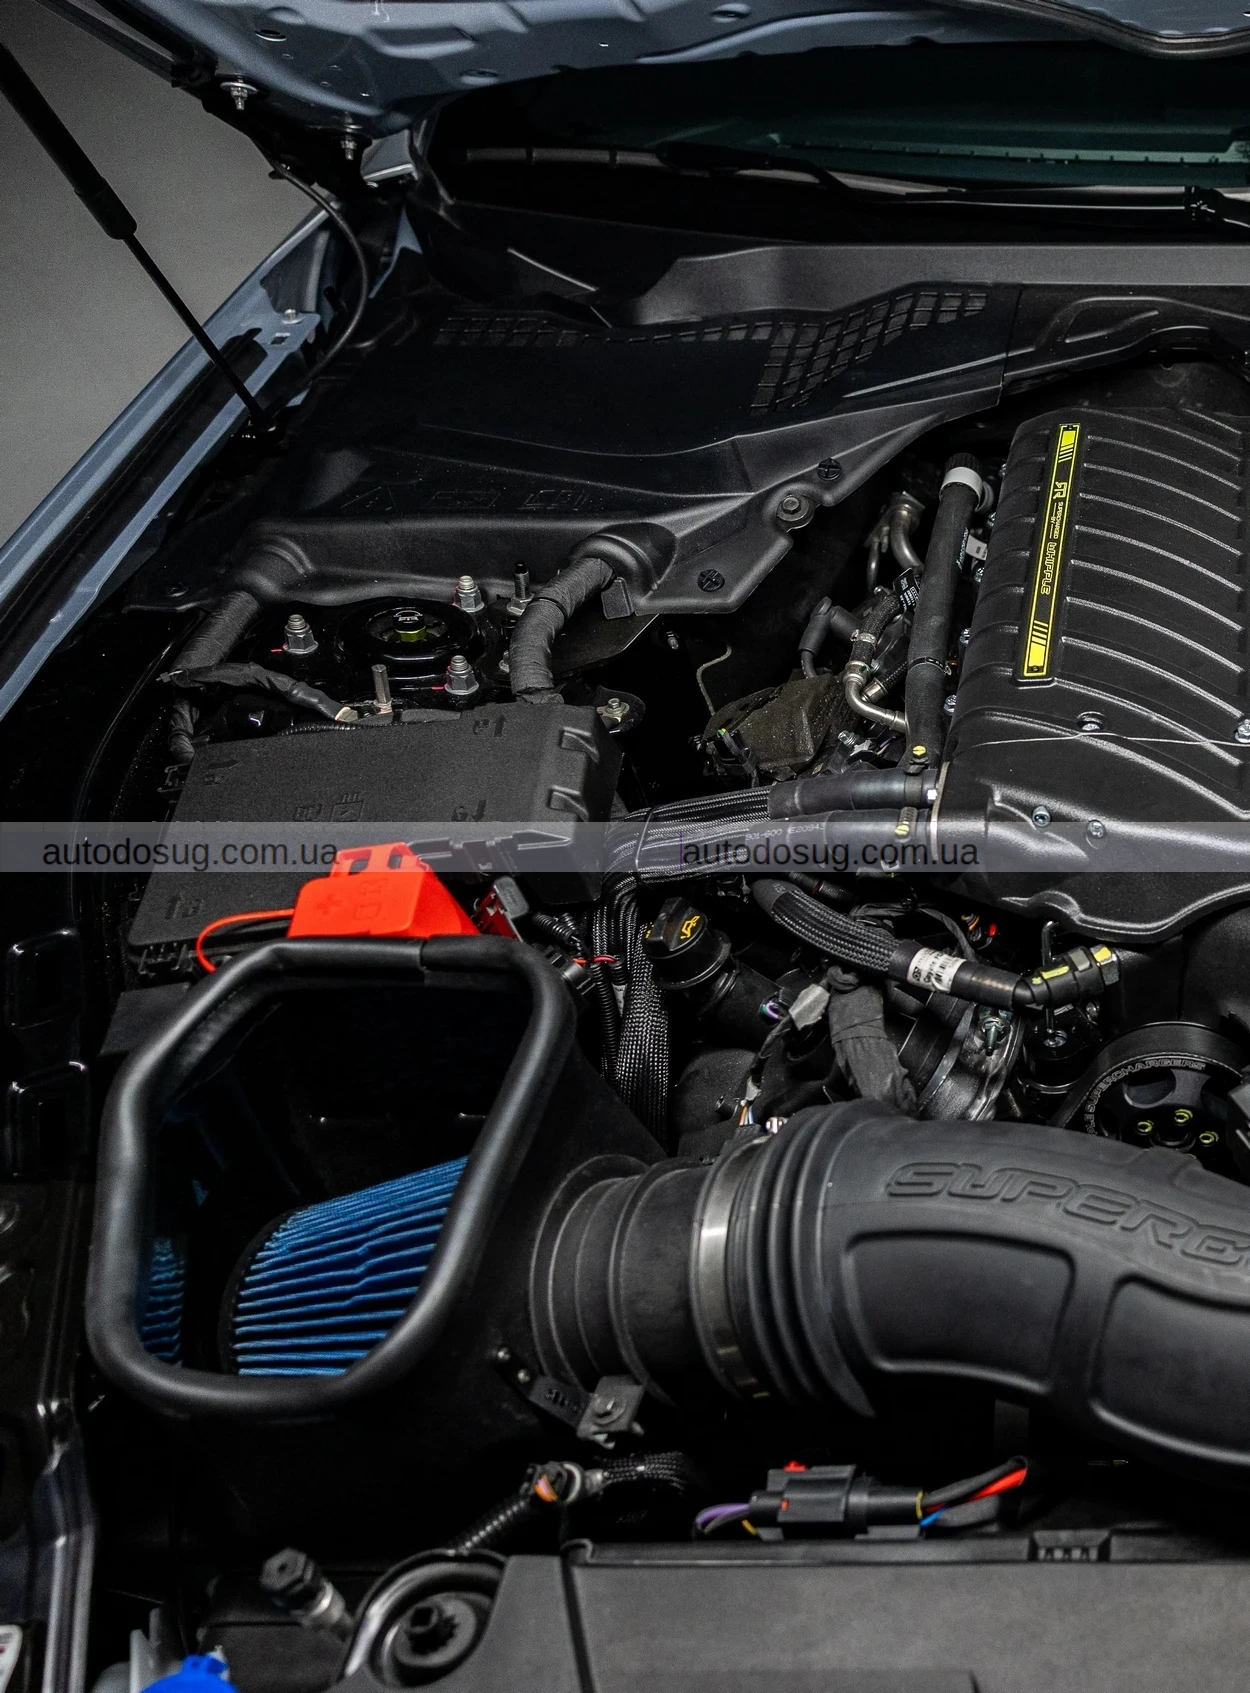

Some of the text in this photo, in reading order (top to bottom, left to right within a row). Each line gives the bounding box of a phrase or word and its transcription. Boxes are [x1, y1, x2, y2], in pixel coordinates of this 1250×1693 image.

[1050, 516, 1056, 525] BY
[1053, 502, 1064, 539] SUPERCHARGED
[1041, 541, 1057, 595] WHIPPLE
